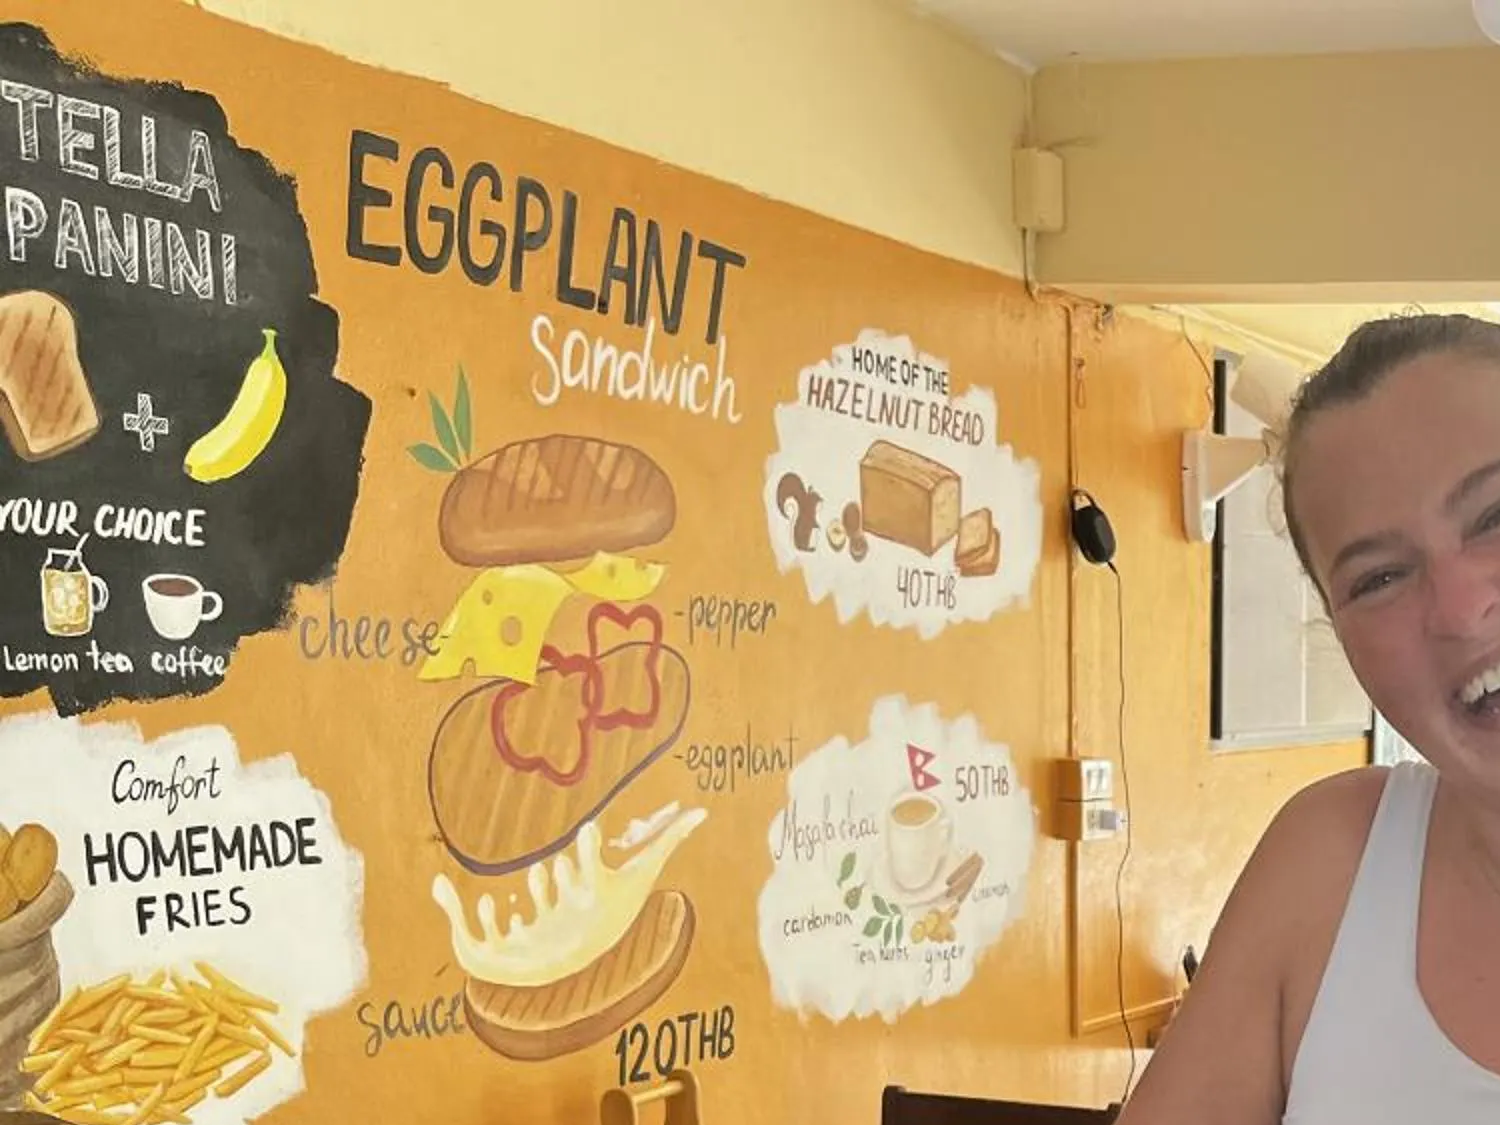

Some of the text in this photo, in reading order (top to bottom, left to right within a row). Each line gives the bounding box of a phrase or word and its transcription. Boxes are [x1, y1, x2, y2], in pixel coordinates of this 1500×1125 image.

[1, 79, 222, 212] TELLA
[5, 186, 237, 305] PANINI
[346, 128, 747, 344] EGGPLANT
[530, 314, 743, 423] Sandwich
[852, 347, 949, 395] HOME OF THE
[808, 374, 985, 446] HAZELNUT BREAD
[0, 497, 206, 546] YOUR CHOICE
[3, 640, 134, 673] Lemon tea
[152, 646, 226, 677] coffee
[112, 756, 222, 815] Comfort
[955, 764, 1010, 801] 50THB
[84, 817, 323, 886] HOMEMADE
[136, 887, 252, 935] FRIES
[356, 991, 466, 1058] sauce
